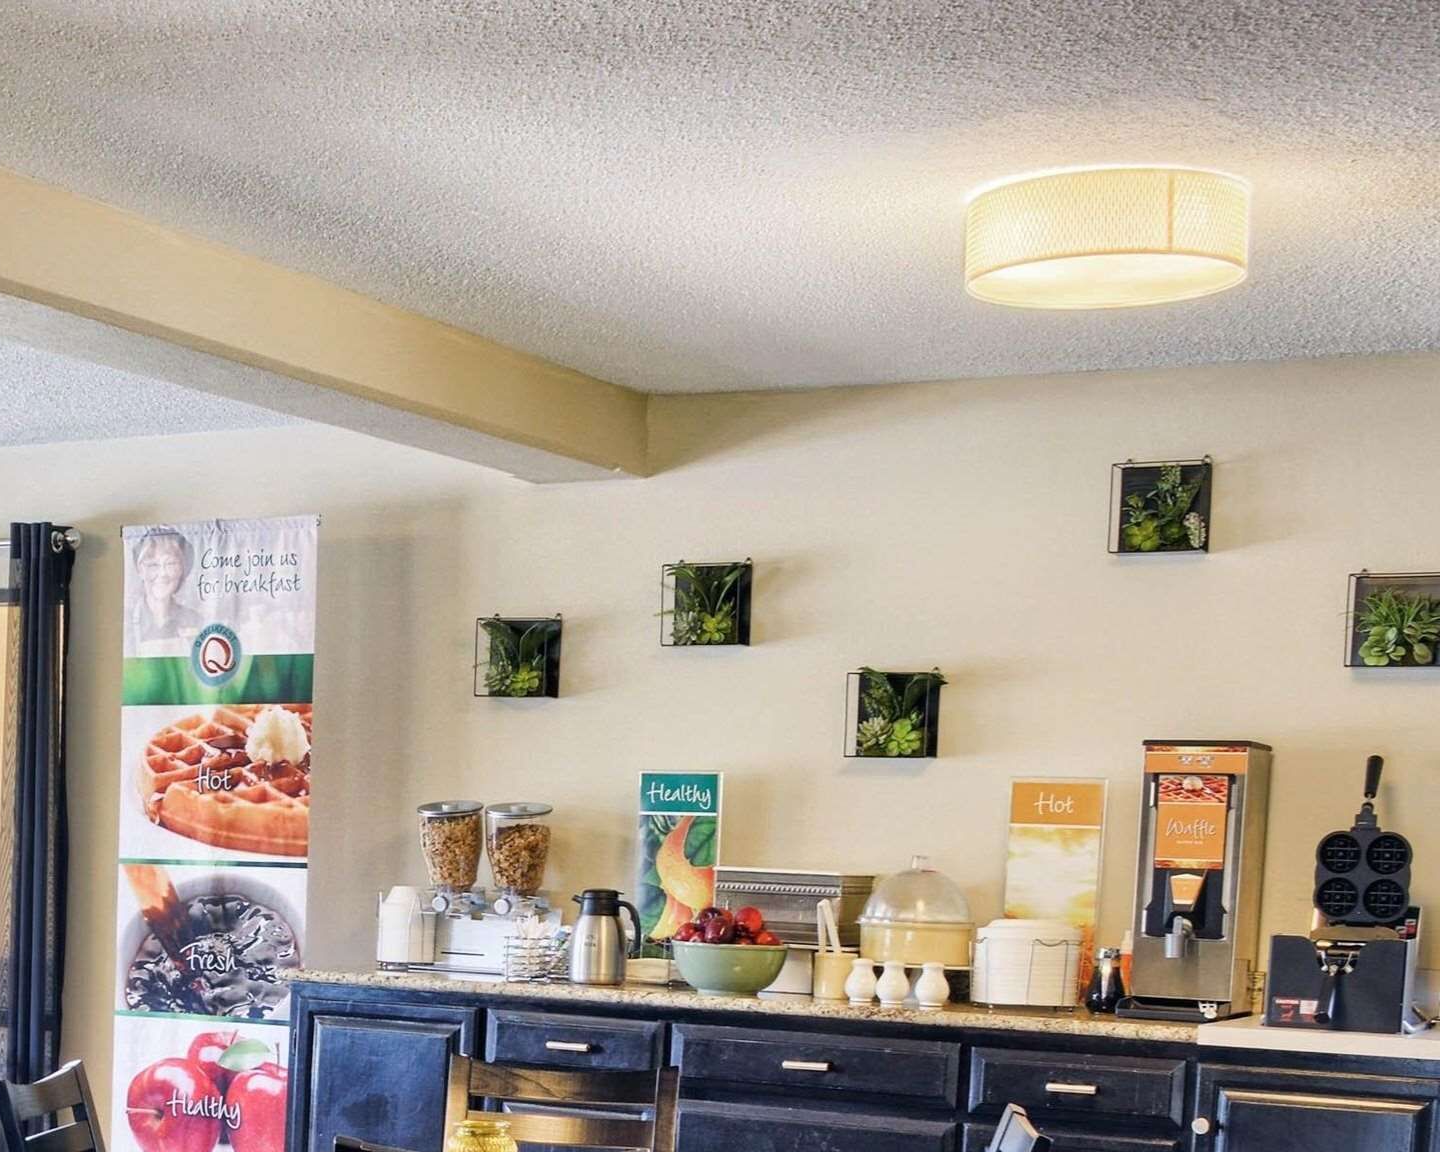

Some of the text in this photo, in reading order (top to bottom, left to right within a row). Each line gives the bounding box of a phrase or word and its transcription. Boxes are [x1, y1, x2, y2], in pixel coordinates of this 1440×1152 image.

[201, 548, 298, 577] Come join us
[196, 571, 301, 601] for breakfast
[202, 637, 237, 674] Q
[196, 767, 232, 792] Hot
[646, 781, 711, 810] Healthy
[1033, 791, 1075, 815] Hot
[1165, 818, 1217, 840] Waffle
[179, 943, 238, 971] Fresh
[166, 1091, 241, 1129] Healthy
